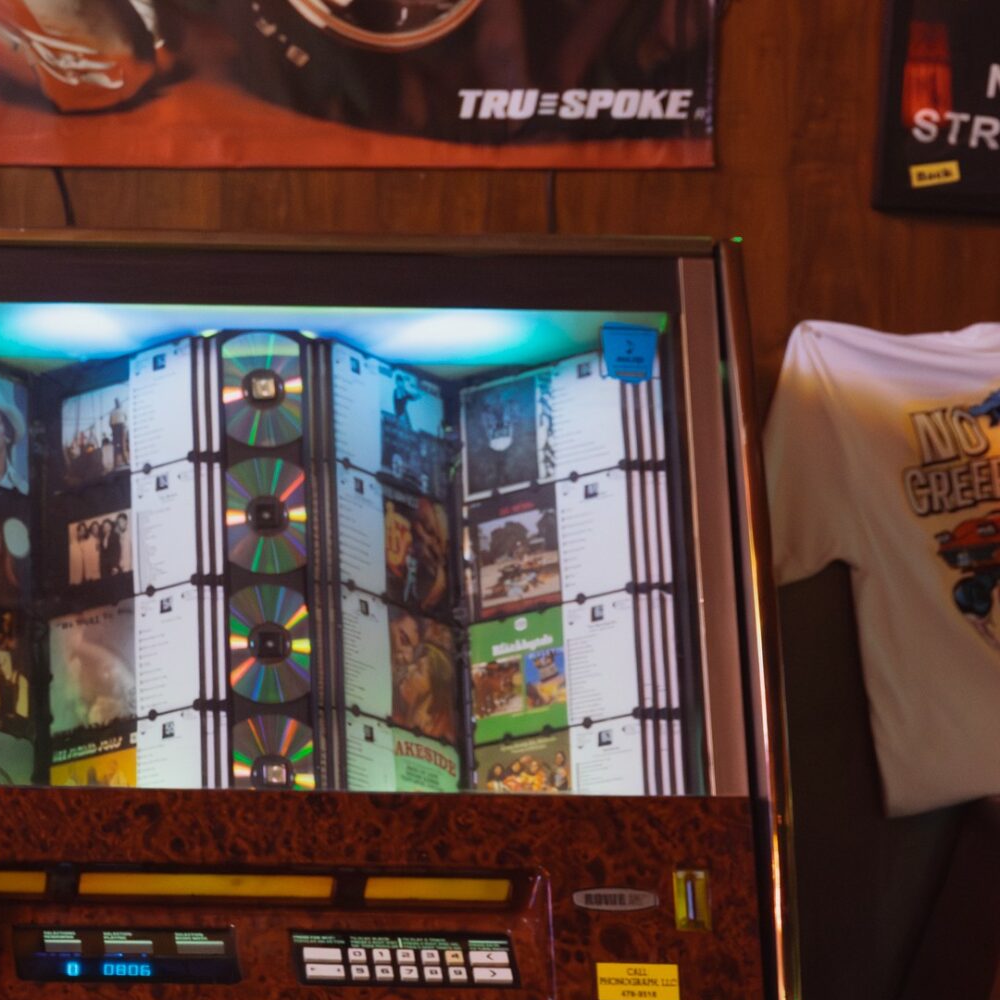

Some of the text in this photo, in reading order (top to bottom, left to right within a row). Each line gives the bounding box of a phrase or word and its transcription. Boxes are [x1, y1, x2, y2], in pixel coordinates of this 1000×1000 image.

[909, 405, 989, 466] NO
[394, 740, 456, 778] AKESIDE
[626, 967, 647, 977] CALL
